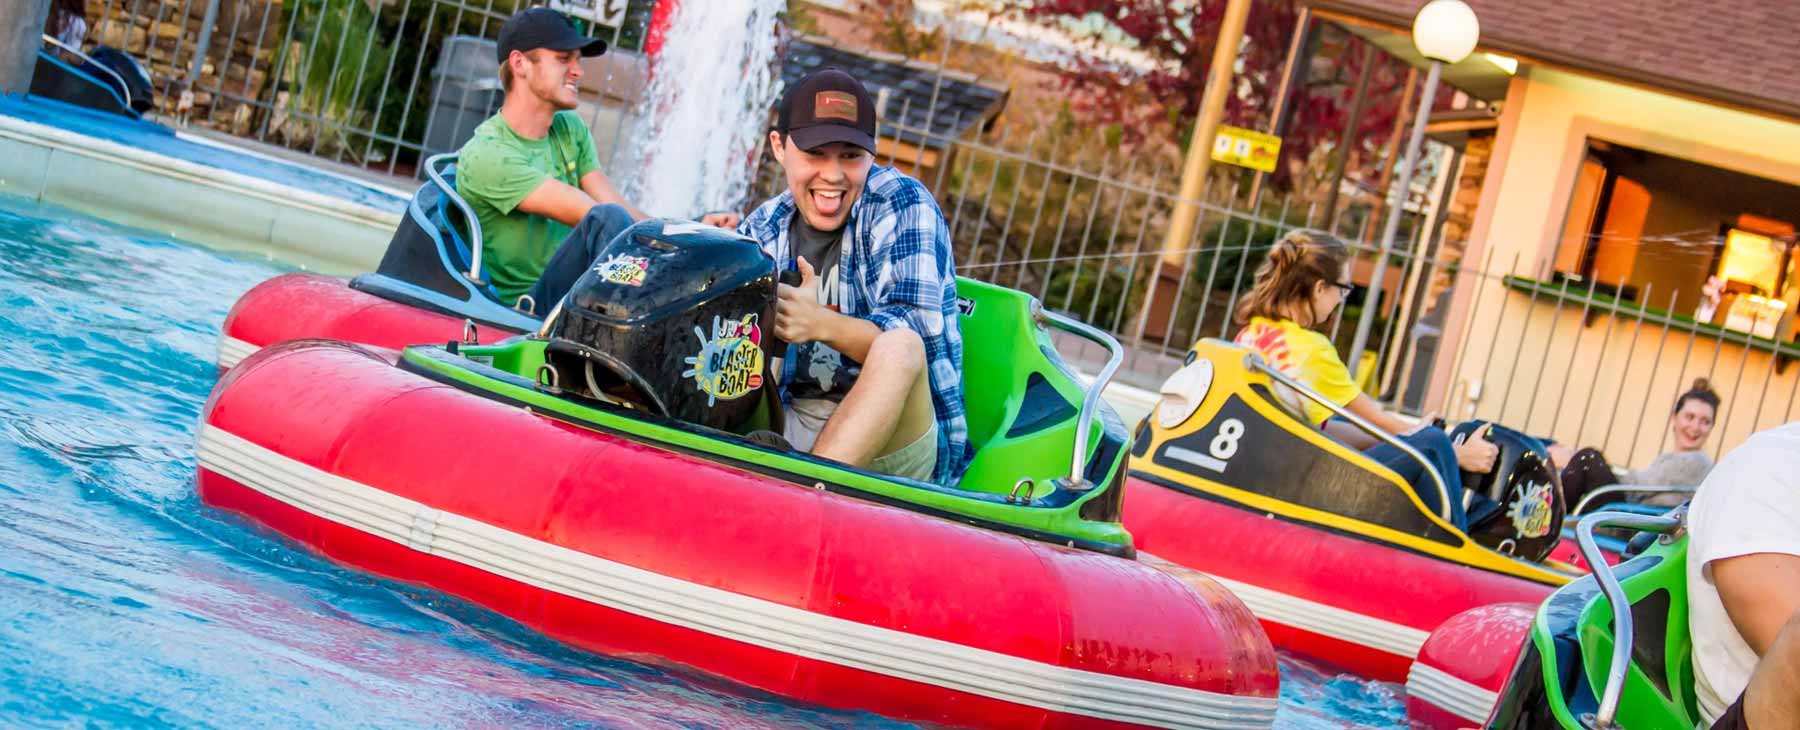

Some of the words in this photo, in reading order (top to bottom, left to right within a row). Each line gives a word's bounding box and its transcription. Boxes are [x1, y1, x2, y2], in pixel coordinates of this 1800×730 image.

[710, 344, 758, 373] BLASTER
[719, 369, 753, 395] BOAT
[1209, 418, 1245, 460] 8
